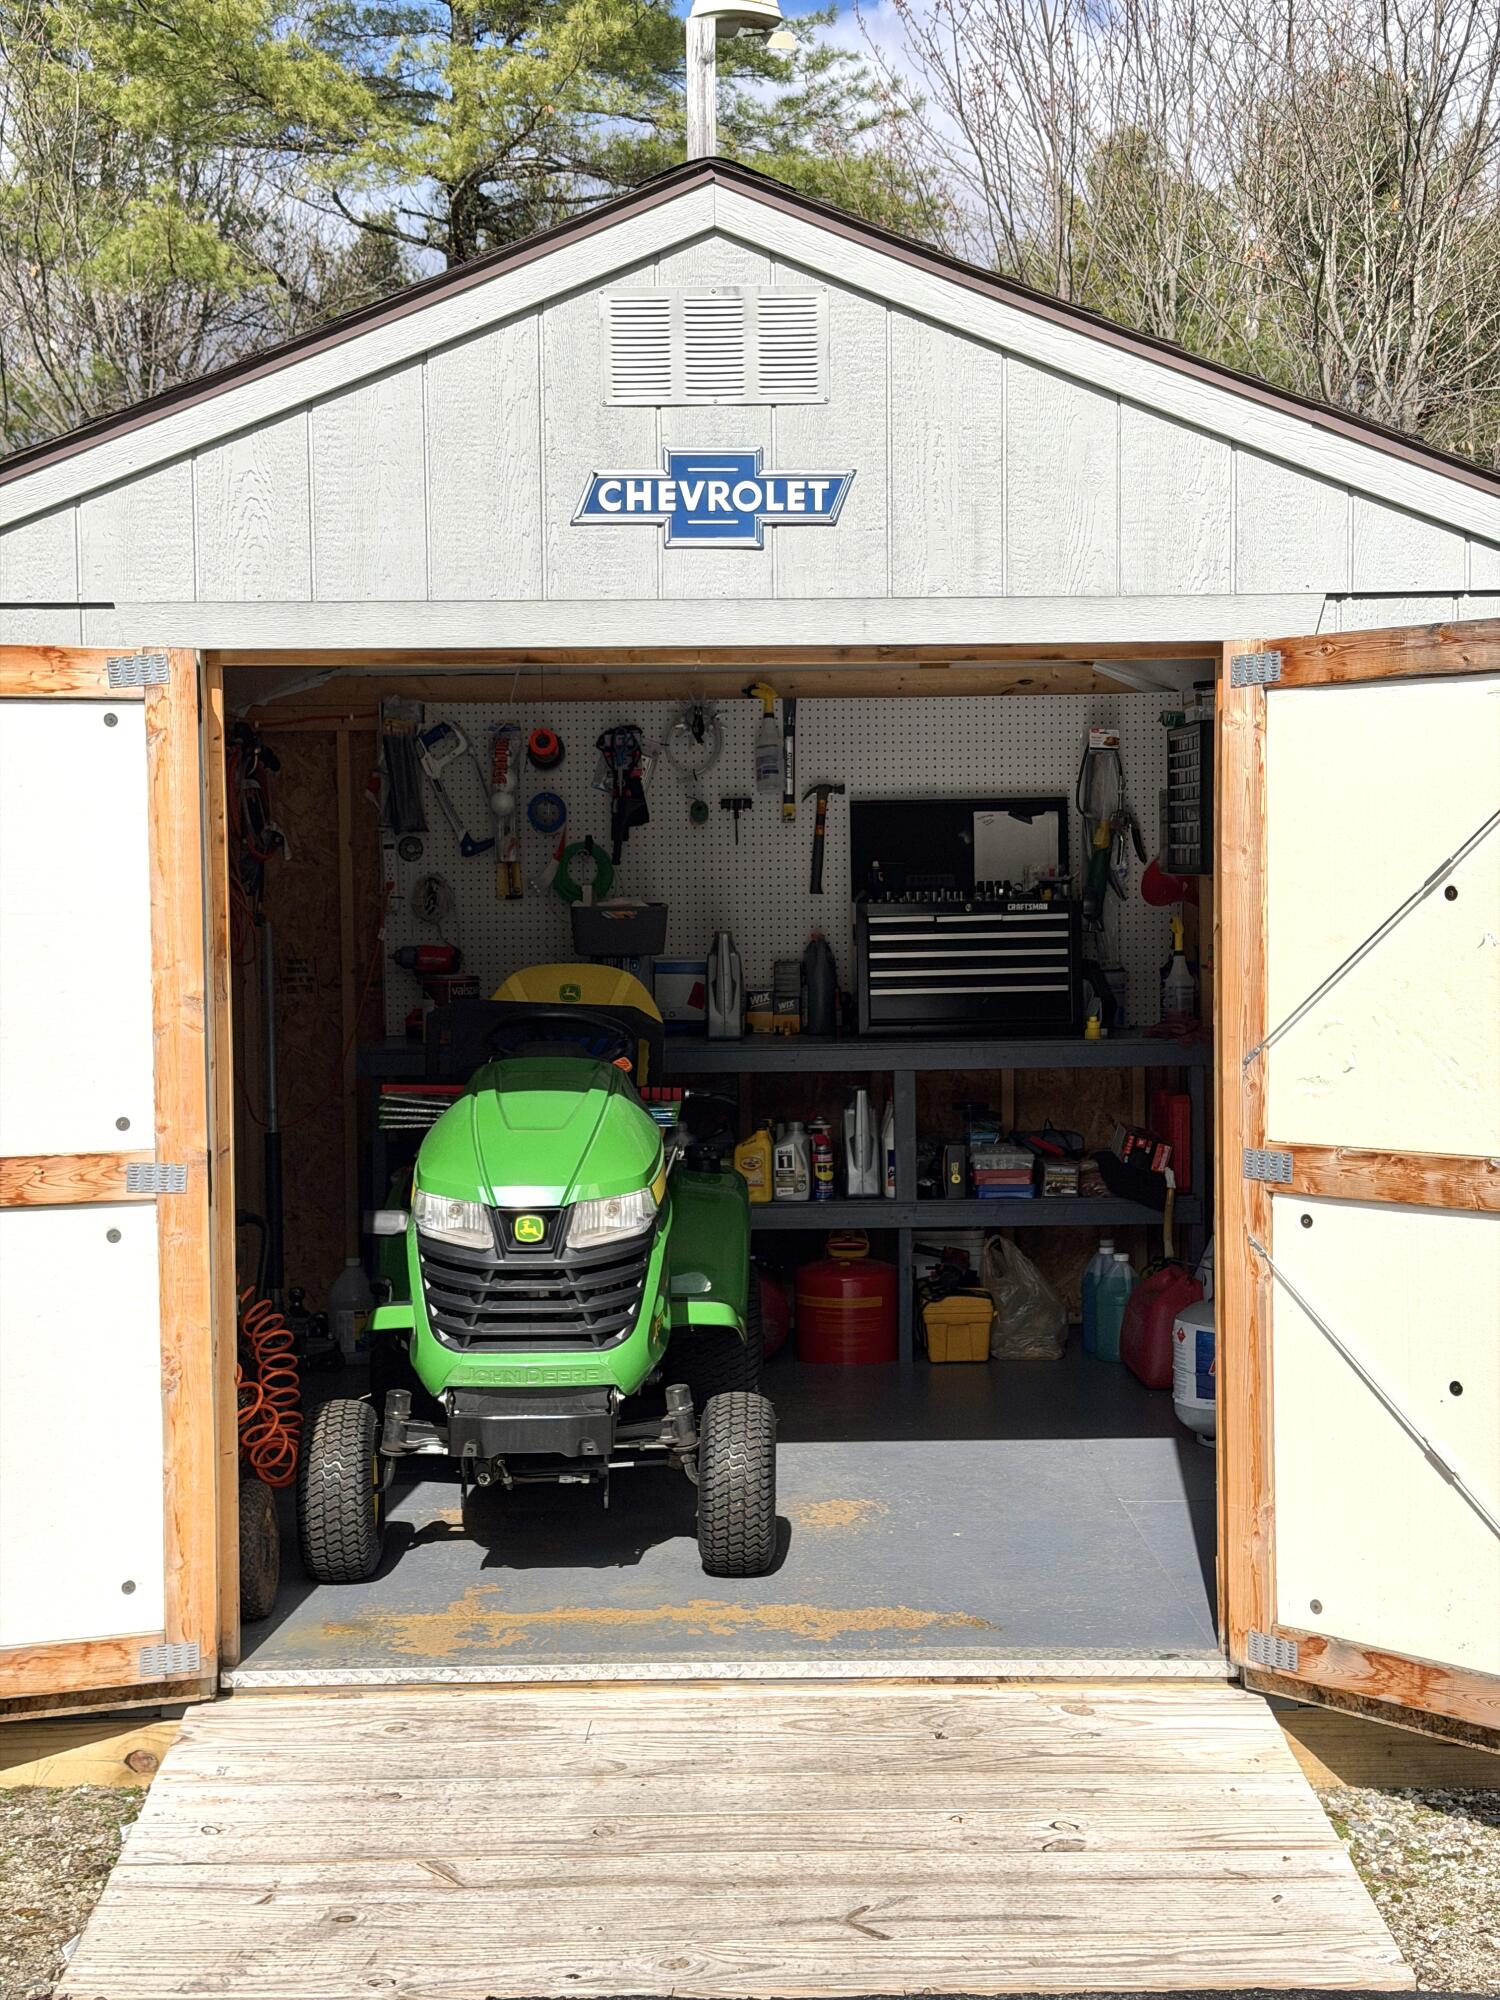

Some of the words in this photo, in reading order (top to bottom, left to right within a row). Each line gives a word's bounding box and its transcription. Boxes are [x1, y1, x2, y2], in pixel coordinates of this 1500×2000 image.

[598, 480, 830, 512] CHEVROLET
[1007, 902, 1049, 911] CRAFTSMAN
[750, 991, 771, 1006] WIX
[778, 999, 796, 1010] WIX
[464, 1367, 521, 1383] JOHN
[526, 1367, 600, 1384] DEERE
